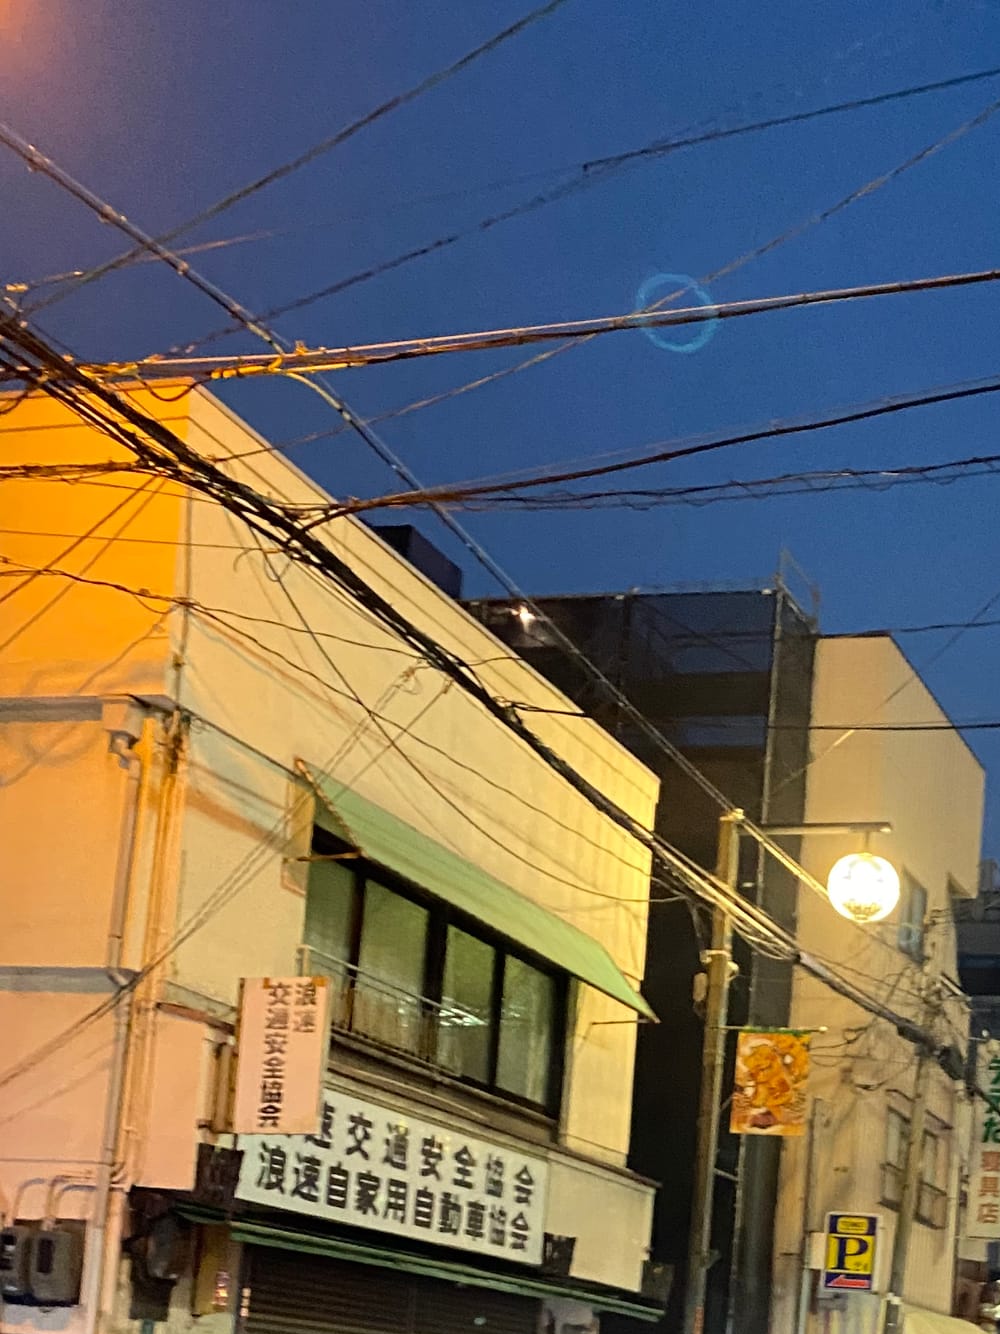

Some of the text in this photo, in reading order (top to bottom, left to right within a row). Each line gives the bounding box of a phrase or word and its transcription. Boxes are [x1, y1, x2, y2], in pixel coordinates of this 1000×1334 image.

[257, 1141, 530, 1251] 浪速自家用自動車協会
[302, 1101, 535, 1207] 速交通安全協会
[831, 1236, 868, 1270] P
